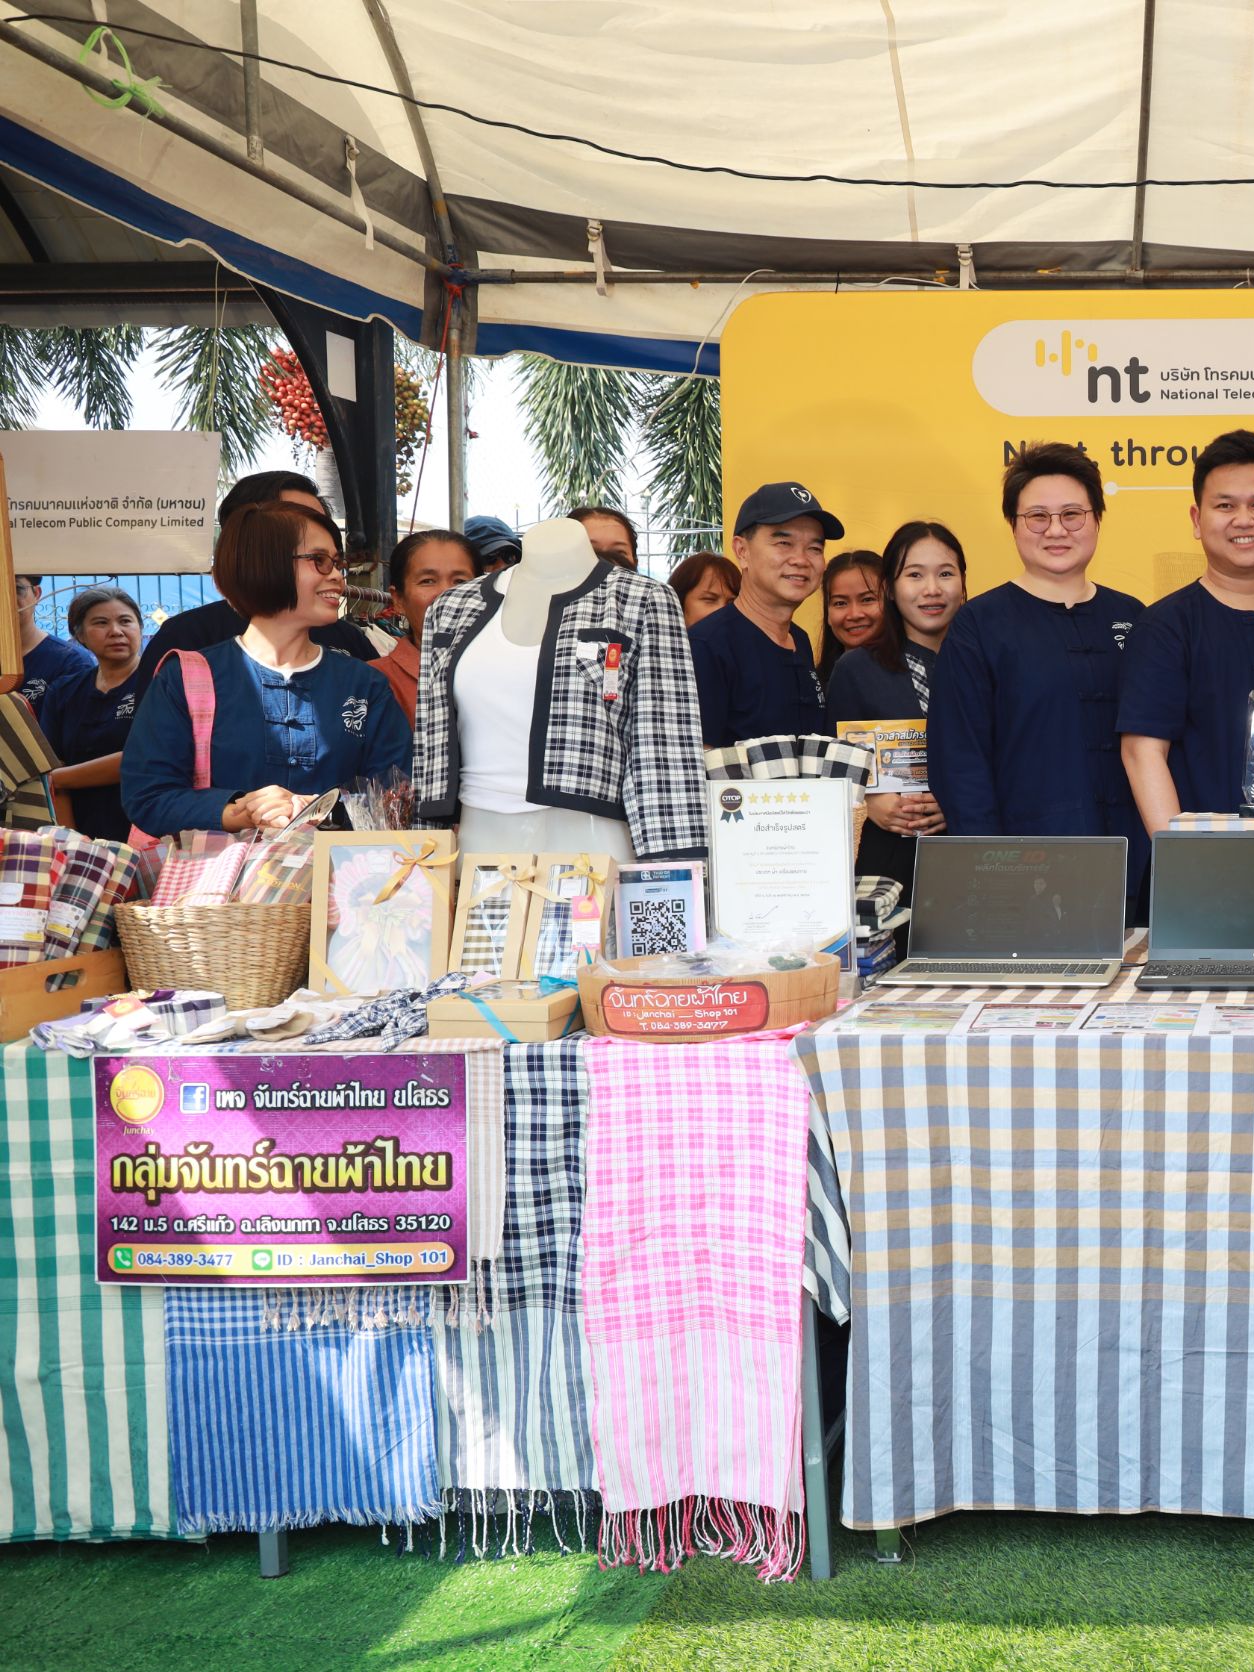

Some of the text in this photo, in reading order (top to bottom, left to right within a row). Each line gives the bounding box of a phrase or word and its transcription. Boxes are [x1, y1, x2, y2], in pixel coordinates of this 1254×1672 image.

[1088, 357, 1151, 403] nt
[1160, 368, 1200, 381] บริษัท
[1160, 388, 1218, 400] National
[8, 496, 206, 511] ทรคมนาคมแห่งชาติ จำกัด (มหาชน)
[20, 517, 66, 528] Telecom
[69, 516, 103, 528] Public
[105, 517, 157, 530] Company
[160, 516, 204, 527] Limited
[721, 794, 742, 802] OTOP
[982, 850, 1021, 863] ONE
[694, 1009, 721, 1019] Shop
[724, 1008, 738, 1016] 101
[216, 1089, 246, 1109] เพจ
[393, 1080, 450, 1107] ยโสธร
[111, 1139, 448, 1200] กลุ่มจันทร์ฉายผ้าไทย
[111, 1212, 451, 1232] 142 ม.5 ต.ศรีแก้ว อ.เลิงนกทา จ.ยโสธร 35120
[137, 1252, 233, 1266] 084-389-3477
[277, 1254, 293, 1266] ID
[309, 1252, 413, 1267] Janchai_Shop
[420, 1251, 447, 1264] 101
